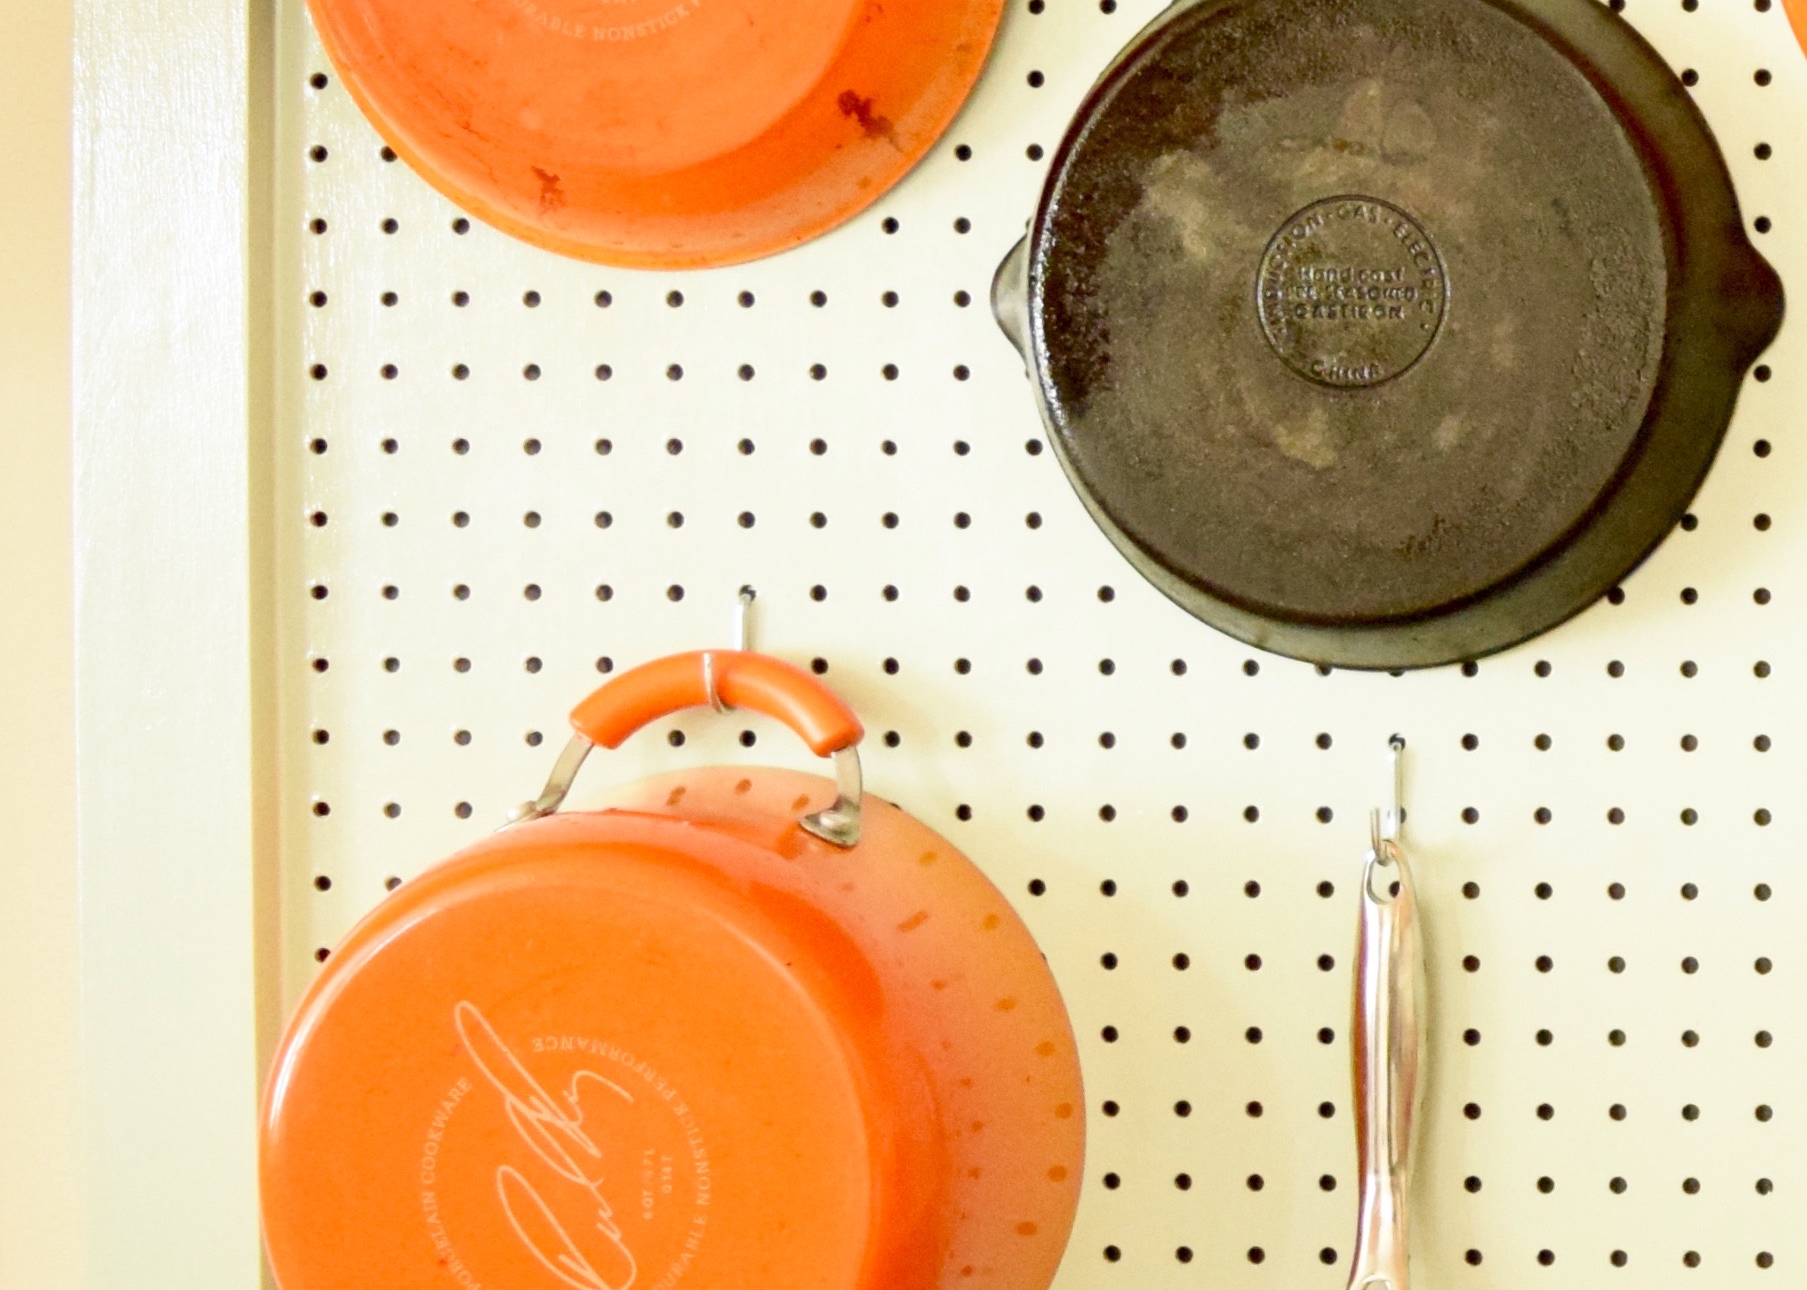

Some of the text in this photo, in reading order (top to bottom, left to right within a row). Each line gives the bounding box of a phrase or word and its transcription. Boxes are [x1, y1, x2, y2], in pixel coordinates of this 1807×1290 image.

[592, 6, 689, 41] NONSTICK
[532, 1036, 677, 1100] PERFORMANCE
[420, 1076, 472, 1184] COOKWARE
